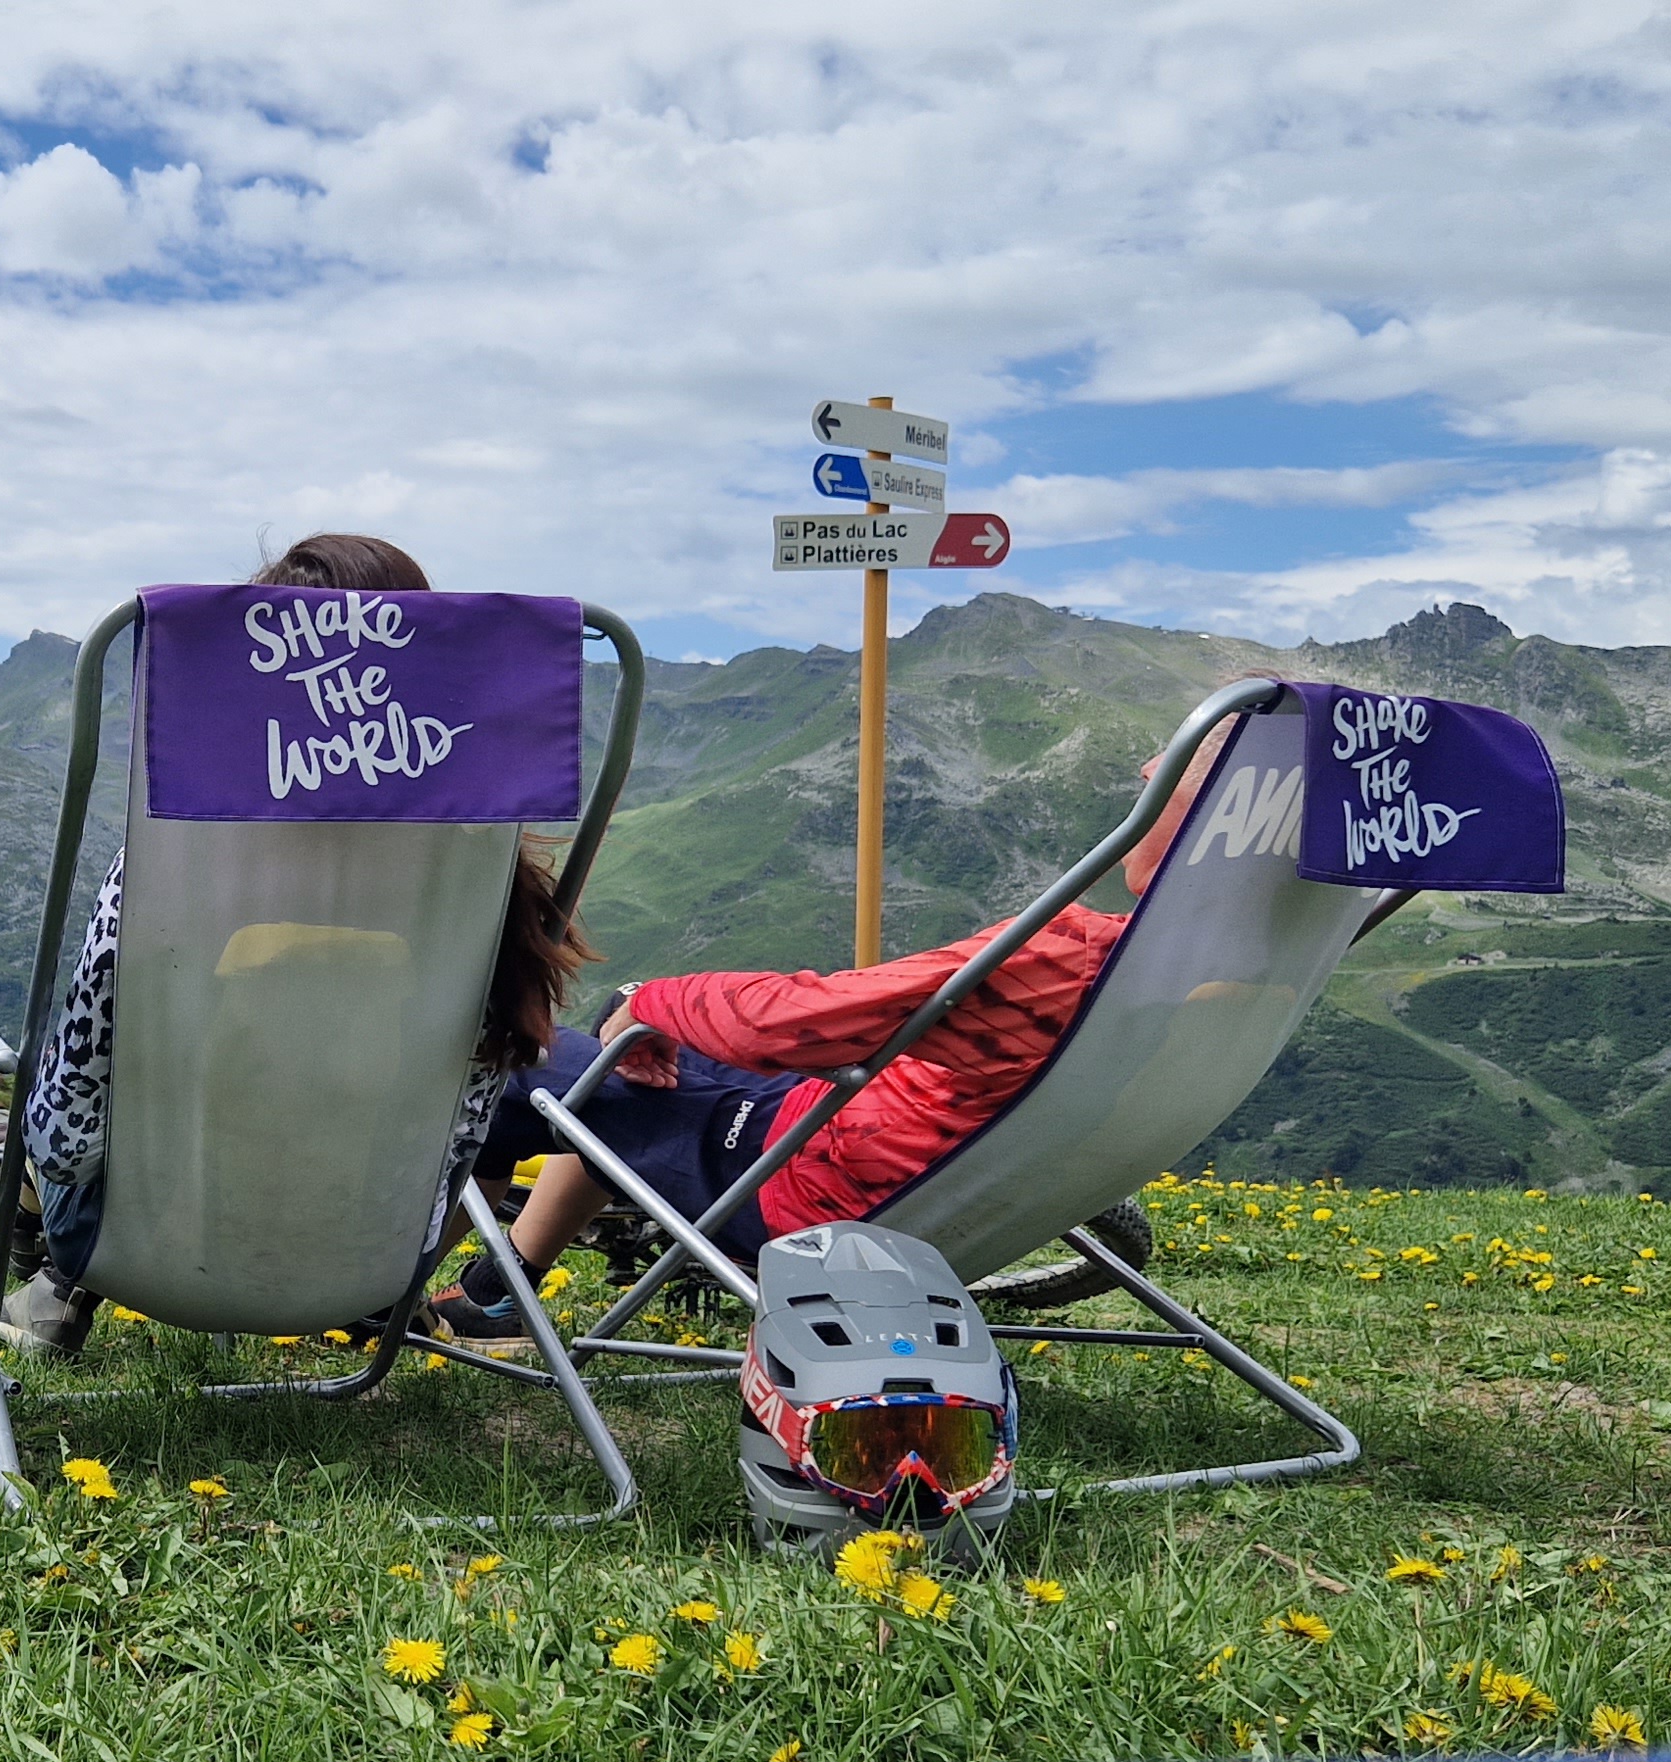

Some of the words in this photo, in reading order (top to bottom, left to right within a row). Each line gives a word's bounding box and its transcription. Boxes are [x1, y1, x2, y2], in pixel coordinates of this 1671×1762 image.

[905, 424, 946, 451] Méribel
[884, 472, 914, 496] Saulire
[914, 478, 943, 502] Express
[802, 521, 840, 539] Pas
[846, 522, 867, 538] du
[872, 520, 908, 538] Lac
[802, 544, 898, 563] Plattières
[865, 1332, 934, 1343] LEATT
